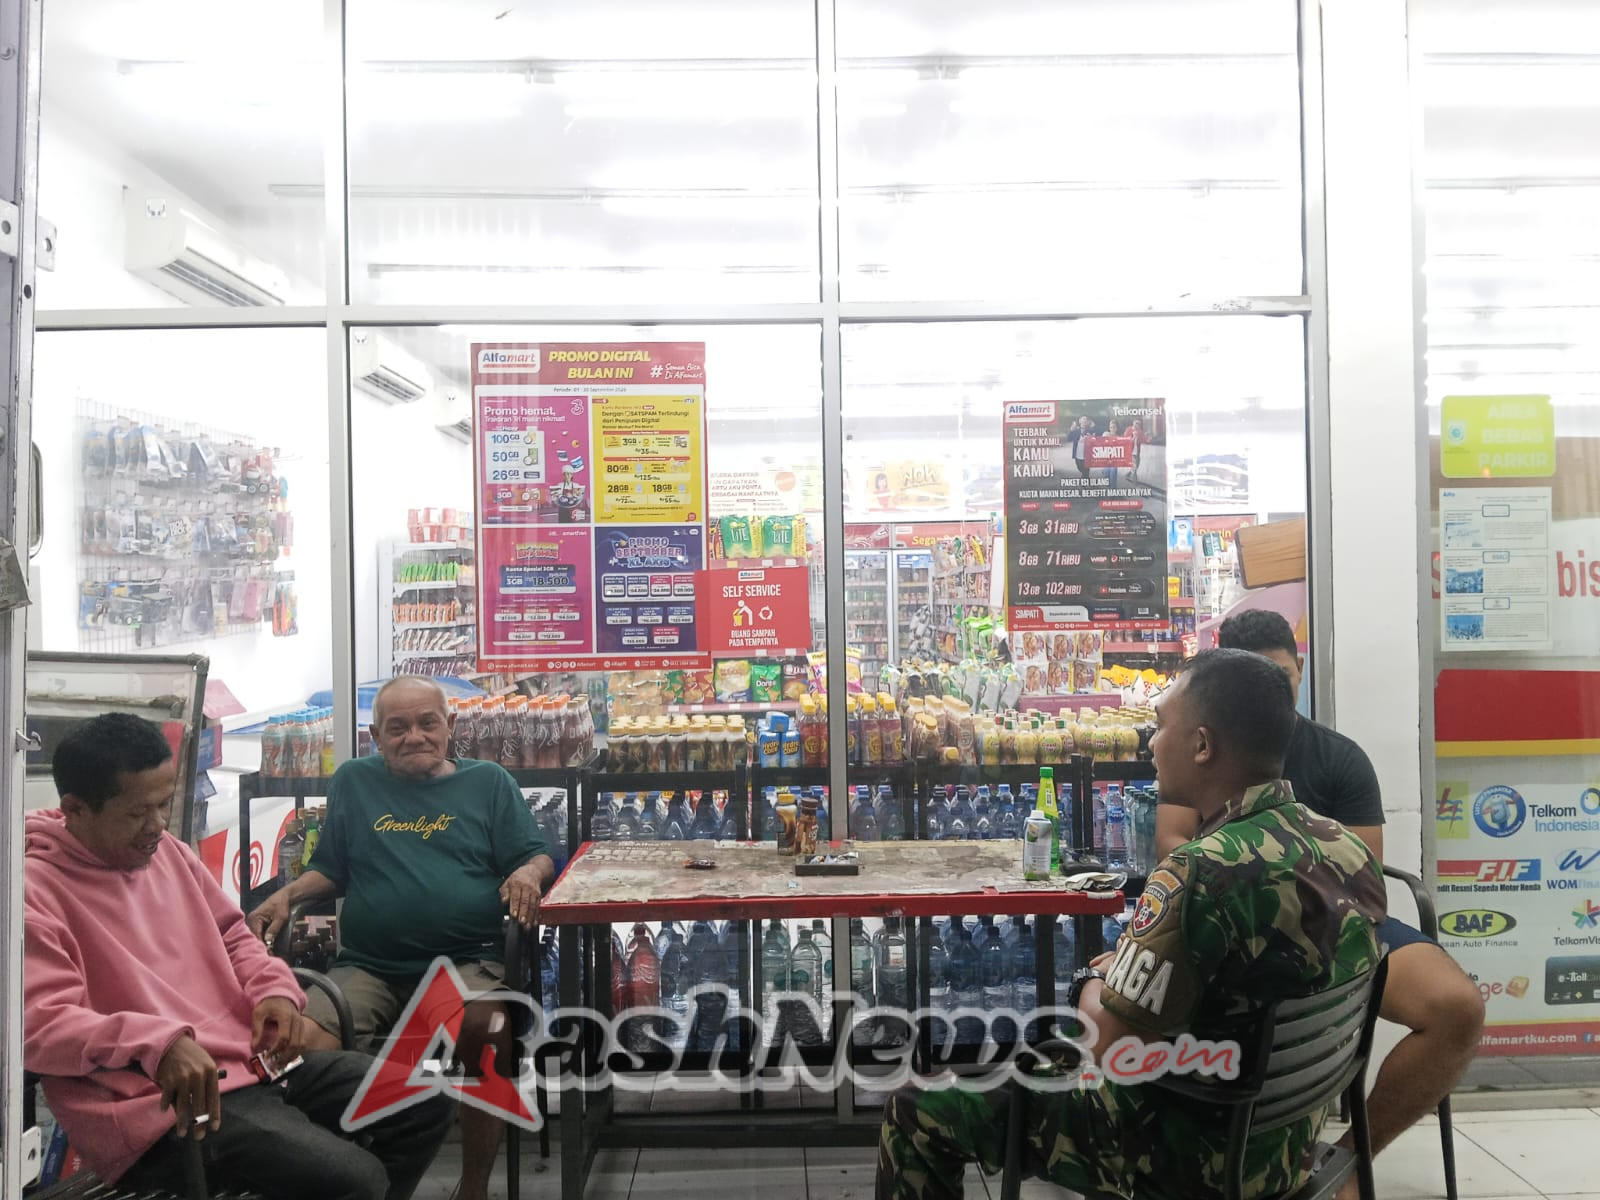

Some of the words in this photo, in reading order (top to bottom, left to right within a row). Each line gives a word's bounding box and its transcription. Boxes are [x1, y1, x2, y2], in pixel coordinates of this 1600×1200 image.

[482, 353, 535, 362] Alfamart
[548, 351, 599, 363] PROMO
[600, 350, 652, 362] DIGITAL
[567, 368, 613, 379] BULAN
[615, 367, 634, 379] INI
[484, 406, 518, 415] Promo
[520, 406, 556, 417] hemat,
[1009, 405, 1051, 414] Alfamart
[1113, 406, 1162, 416] Telkomsel
[1014, 428, 1047, 437] TERBAIK
[1013, 439, 1037, 447] UNTUK
[1013, 448, 1050, 461] KAMU
[1092, 446, 1125, 459] SIMPATI
[1013, 465, 1054, 478] KAMU!
[1061, 479, 1080, 487] PAKET
[1081, 479, 1090, 487] ISI
[1090, 478, 1109, 486] ULANG
[1039, 490, 1059, 498] MAKIN
[1082, 489, 1106, 498] BENEFIT
[1107, 489, 1127, 497] MAKIN
[1128, 488, 1152, 497] BANYAK
[1019, 520, 1039, 534] 3GB
[628, 537, 669, 548] PROMO
[615, 547, 683, 558] SEPTEMBER
[1018, 551, 1039, 566] 8GB
[723, 586, 744, 598] SELF
[745, 584, 781, 597] SERVICE
[1018, 583, 1040, 596] 13GB
[1015, 609, 1039, 619] SIMPATI
[731, 631, 751, 639] BUANG
[752, 629, 776, 638] SAMPAH
[729, 639, 744, 647] PADA
[745, 637, 778, 647] TEMPATNYA
[1529, 804, 1577, 818] Telkom
[374, 814, 456, 840] Greenlight
[1535, 819, 1599, 832] Indonesia
[1451, 883, 1472, 892] Resmi
[1474, 883, 1498, 893] Sepeda
[1500, 883, 1519, 892] Motor
[1520, 883, 1541, 891] Honda
[1453, 913, 1494, 933] BAF
[1463, 940, 1482, 948] Auto
[1485, 939, 1518, 948] Finance
[1478, 1033, 1577, 1046] lfamartku.com
